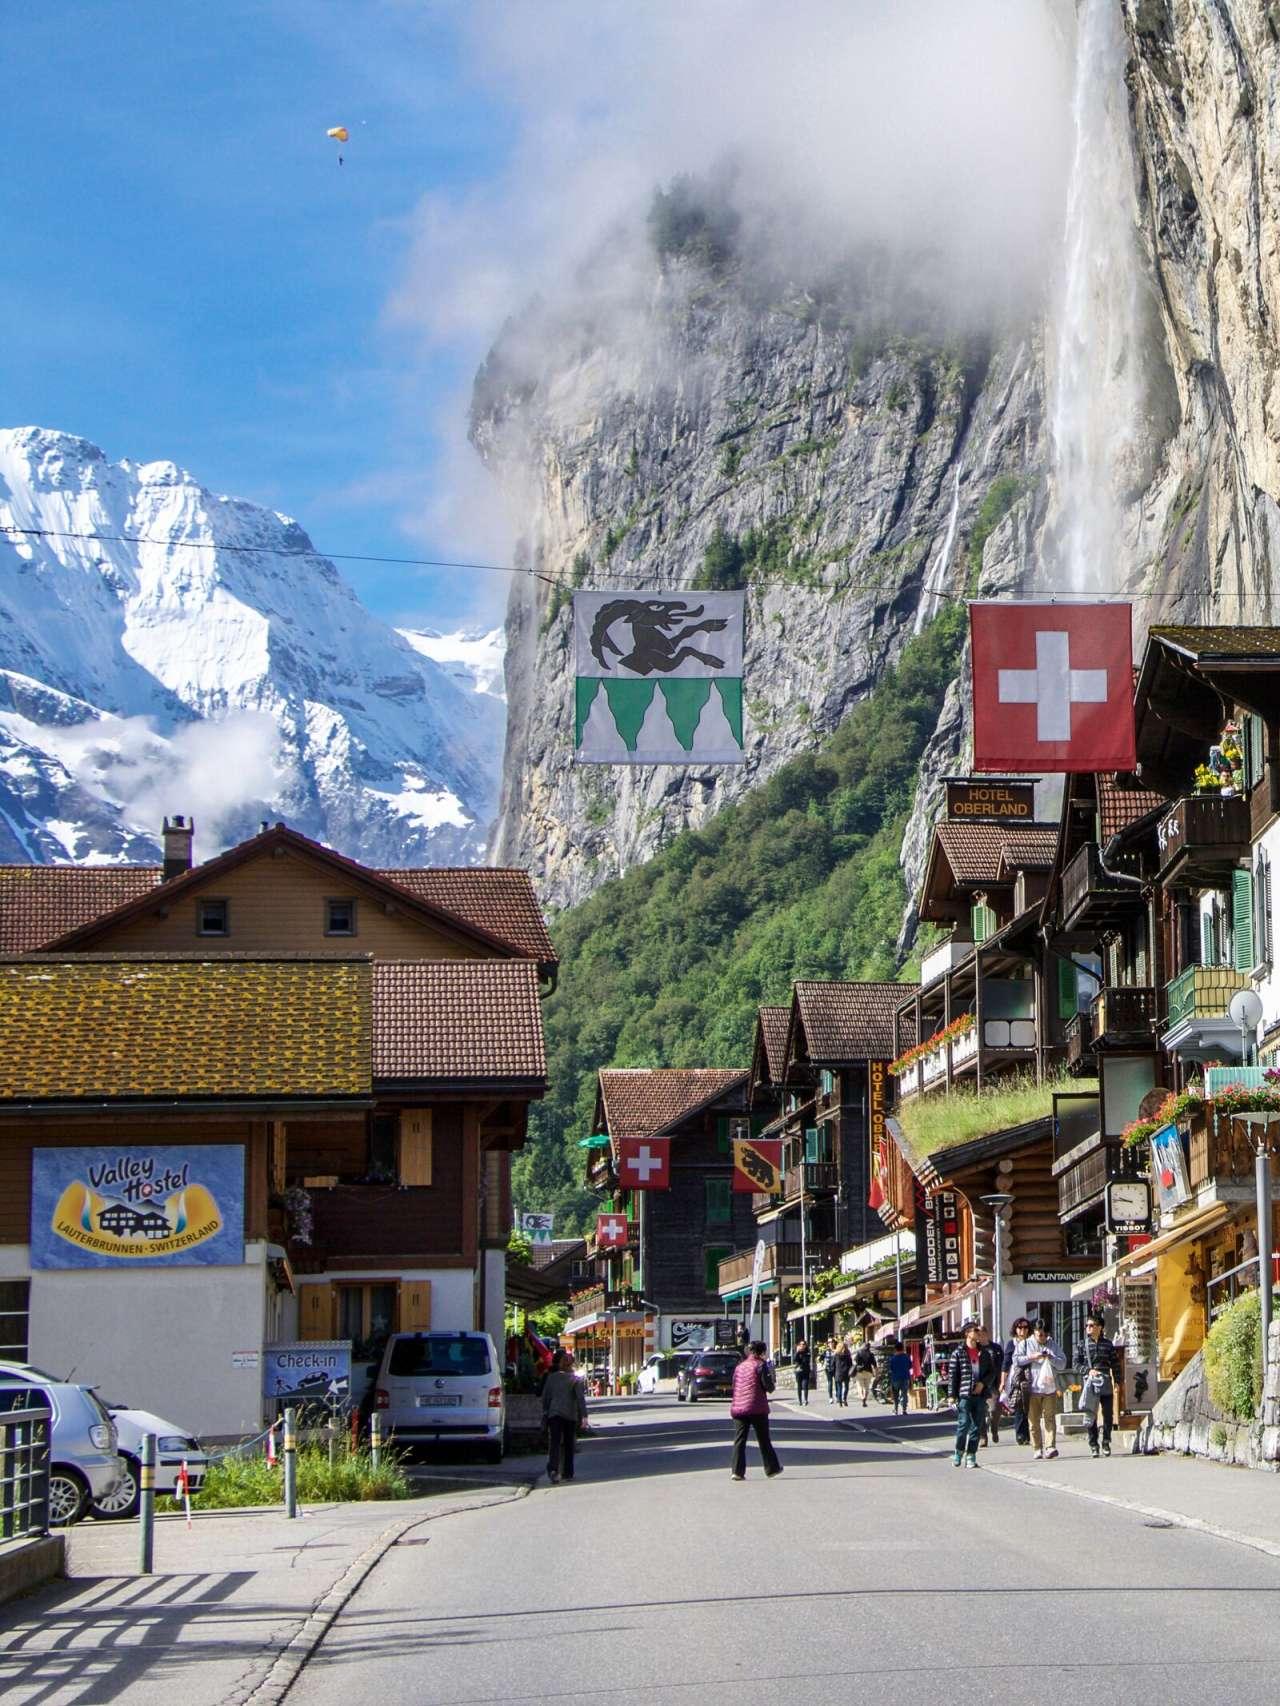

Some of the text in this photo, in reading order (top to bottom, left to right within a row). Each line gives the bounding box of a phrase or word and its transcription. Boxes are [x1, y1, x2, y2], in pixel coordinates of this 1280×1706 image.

[954, 803, 1028, 815] OBERLAND
[969, 789, 1013, 801] HOTEL
[872, 1062, 883, 1111] HOTEL
[88, 1157, 154, 1188] Valley
[122, 1163, 189, 1202] Hostel
[57, 1219, 219, 1254] LAUTERBRUNNEN SWITZERLAND
[926, 1218, 936, 1282] IMBODEN
[276, 1354, 337, 1369] Check-in
